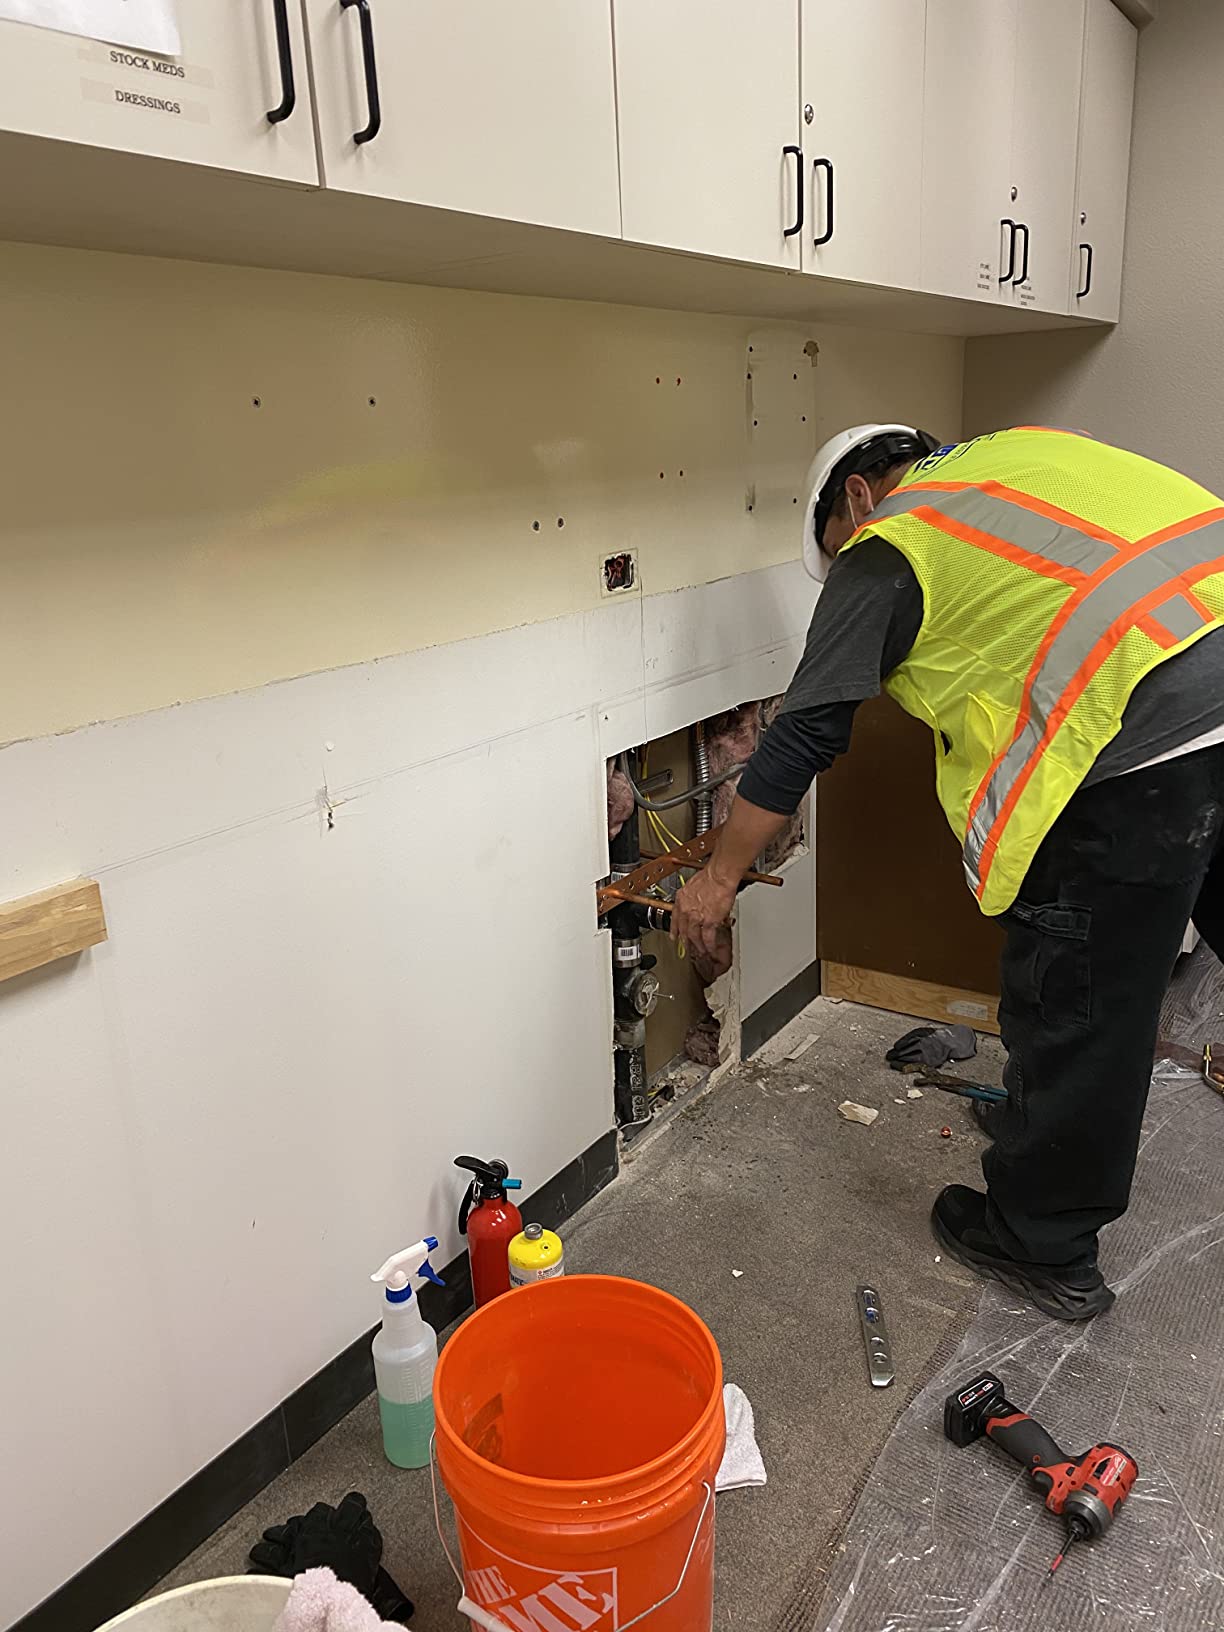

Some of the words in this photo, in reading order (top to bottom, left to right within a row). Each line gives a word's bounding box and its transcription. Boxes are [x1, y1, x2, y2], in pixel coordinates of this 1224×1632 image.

[110, 50, 150, 70] STOCK
[151, 60, 185, 78] MEDS
[115, 89, 181, 114] DRESSINGS
[466, 1565, 517, 1605] THE
